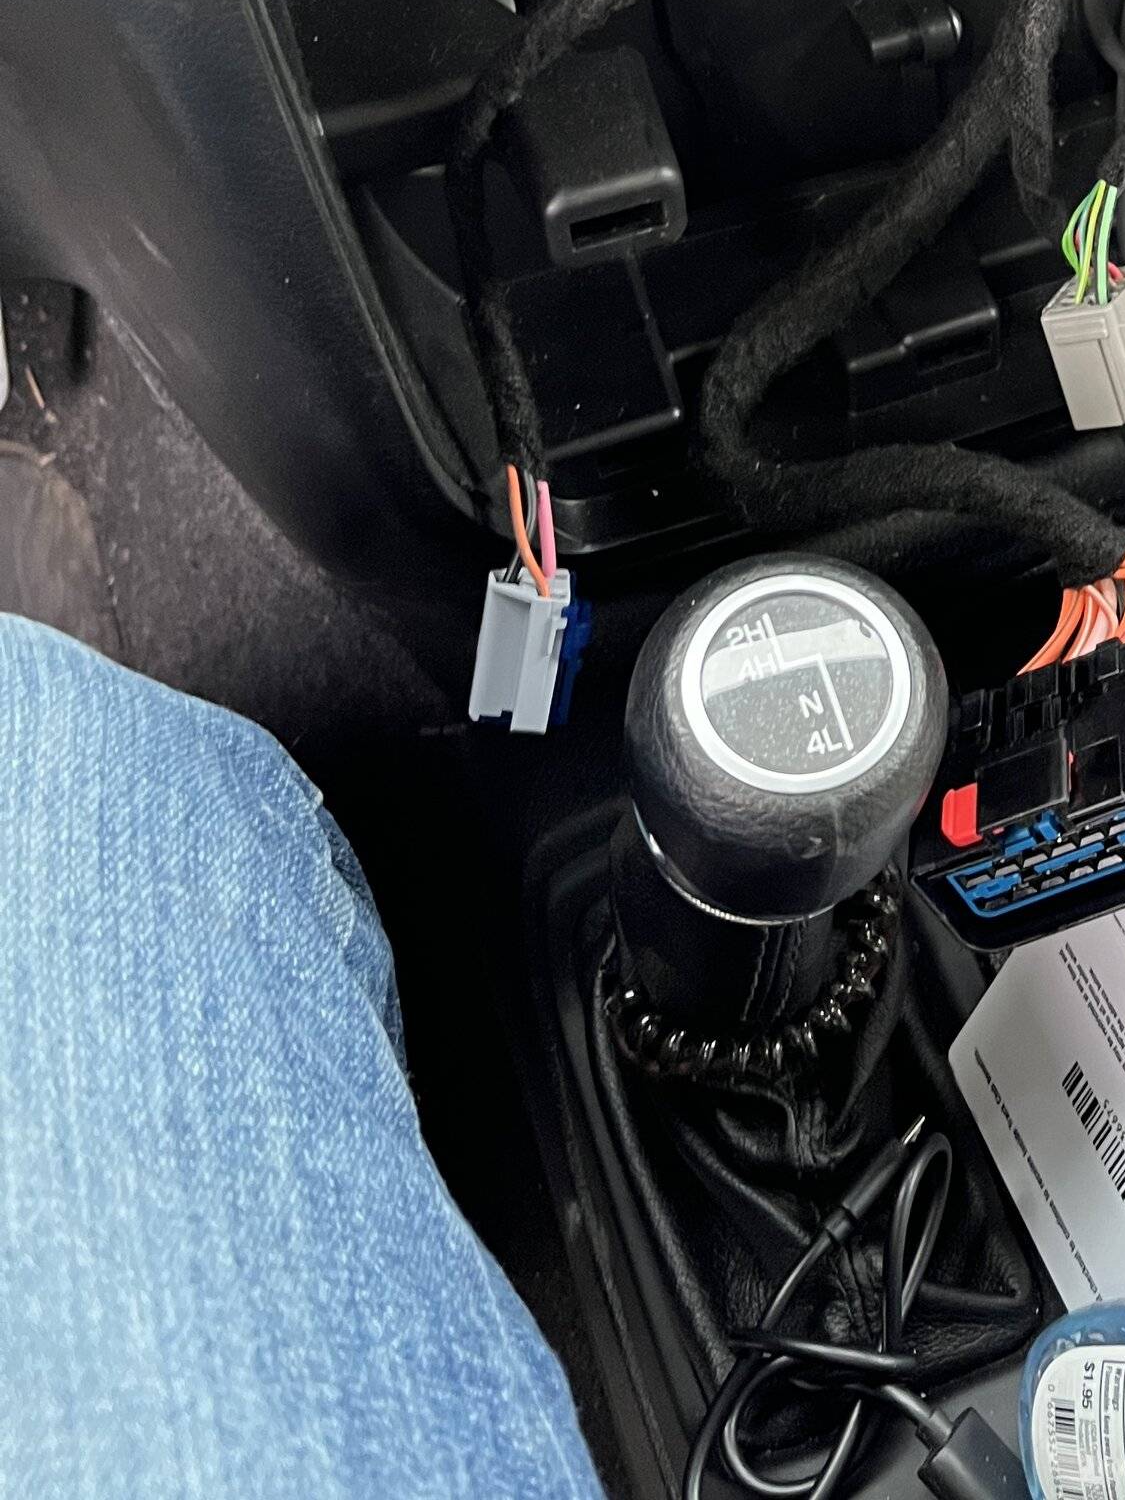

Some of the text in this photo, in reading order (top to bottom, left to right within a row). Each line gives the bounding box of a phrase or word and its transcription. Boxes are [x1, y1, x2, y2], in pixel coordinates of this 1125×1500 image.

[726, 619, 765, 647] 2H
[739, 652, 776, 681] 4H
[798, 689, 825, 718] N
[806, 731, 843, 755] 4L
[1081, 1361, 1096, 1410] $1.95
